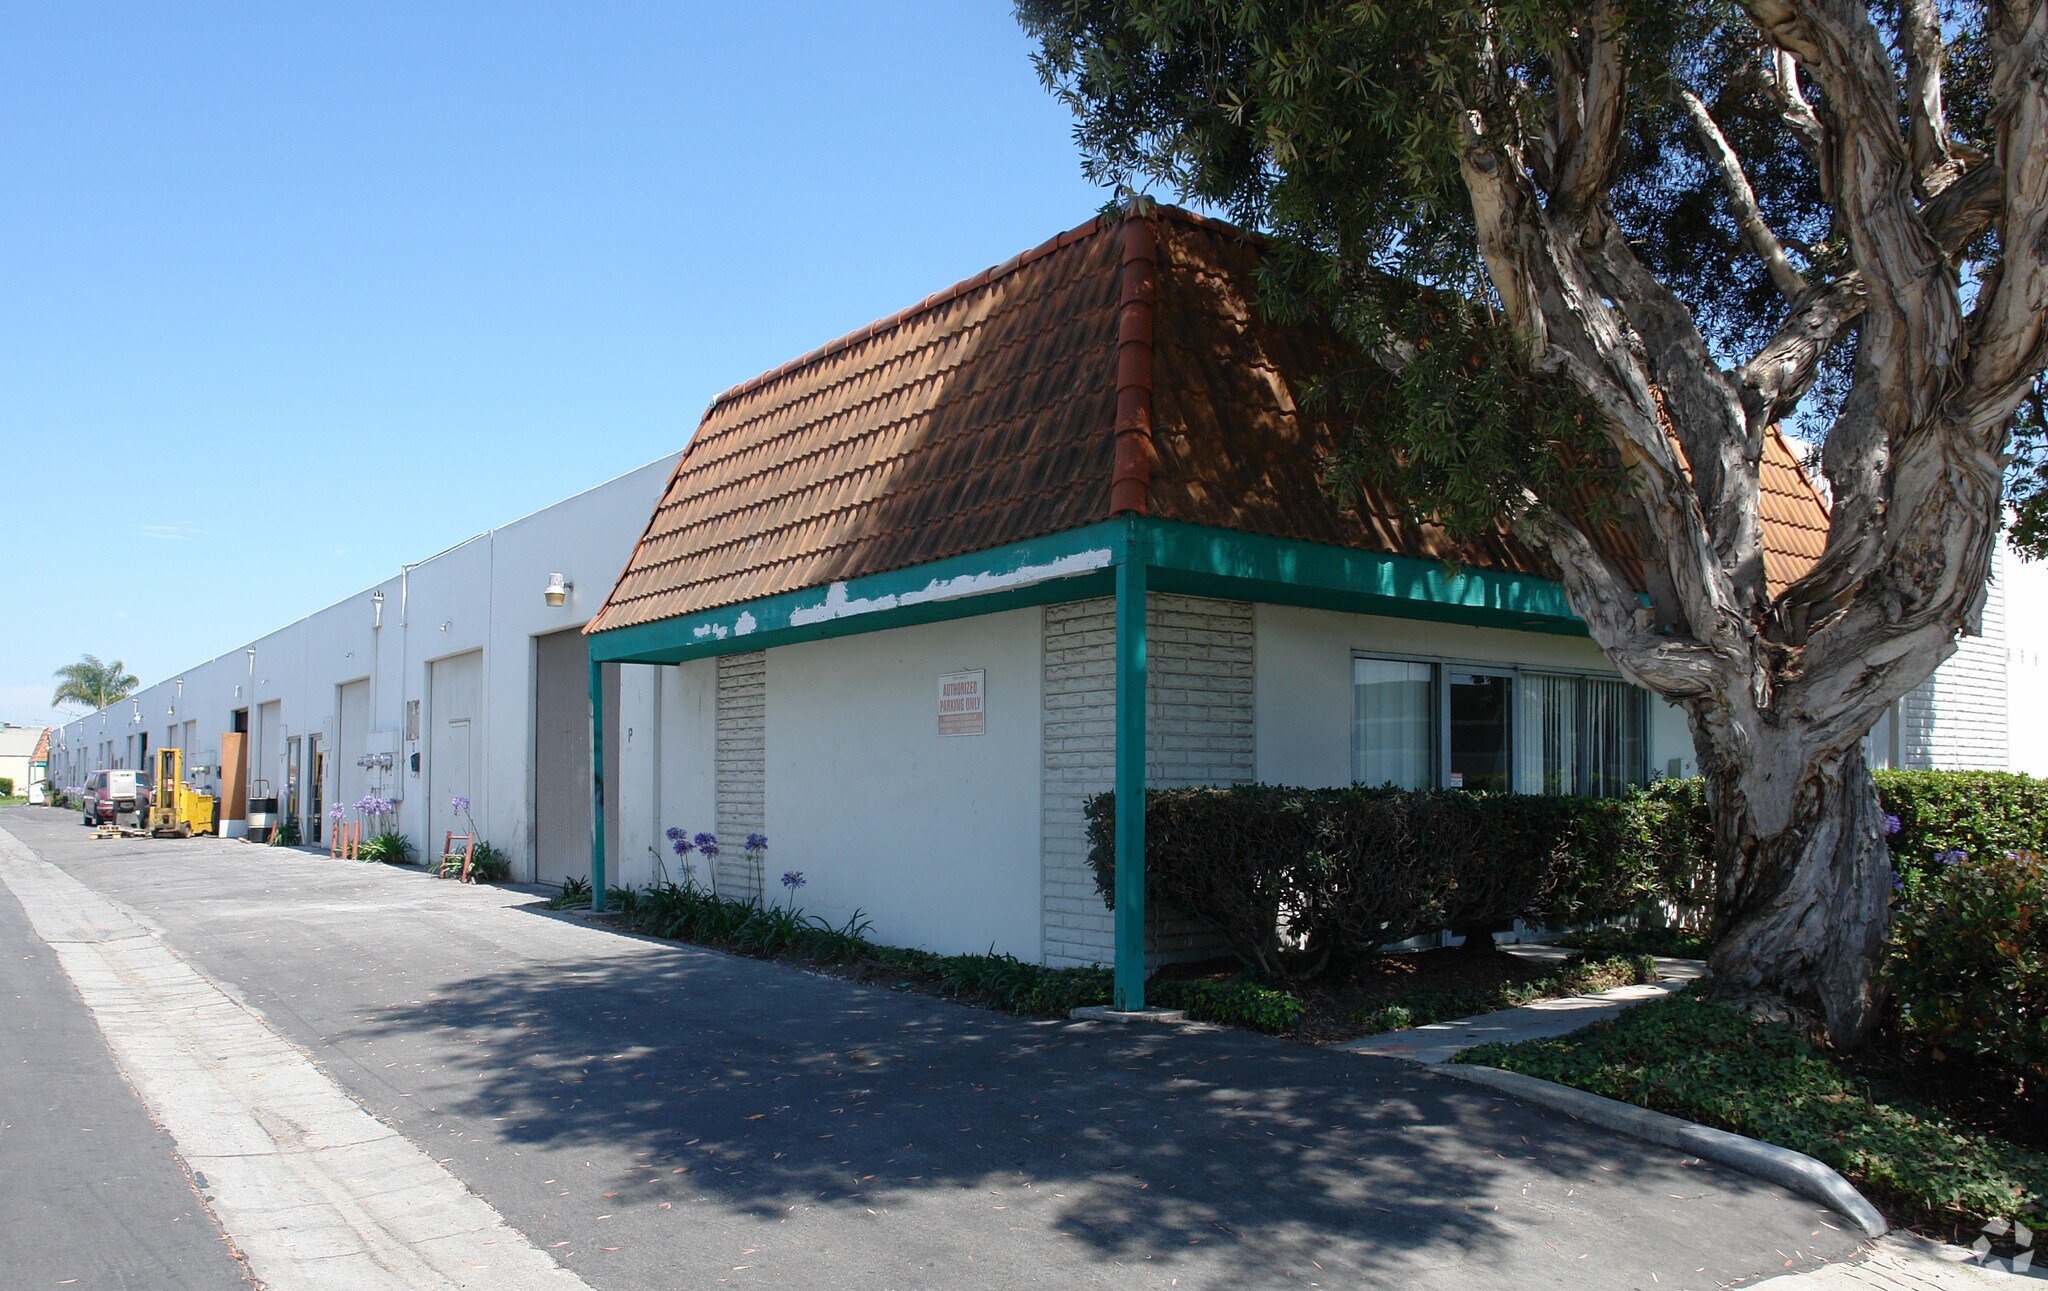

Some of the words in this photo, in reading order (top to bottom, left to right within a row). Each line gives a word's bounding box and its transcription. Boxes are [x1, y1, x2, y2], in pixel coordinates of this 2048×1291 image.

[943, 680, 977, 697] AUTHORIZED
[940, 698, 964, 713] PARKING
[966, 696, 981, 711] ONLY
